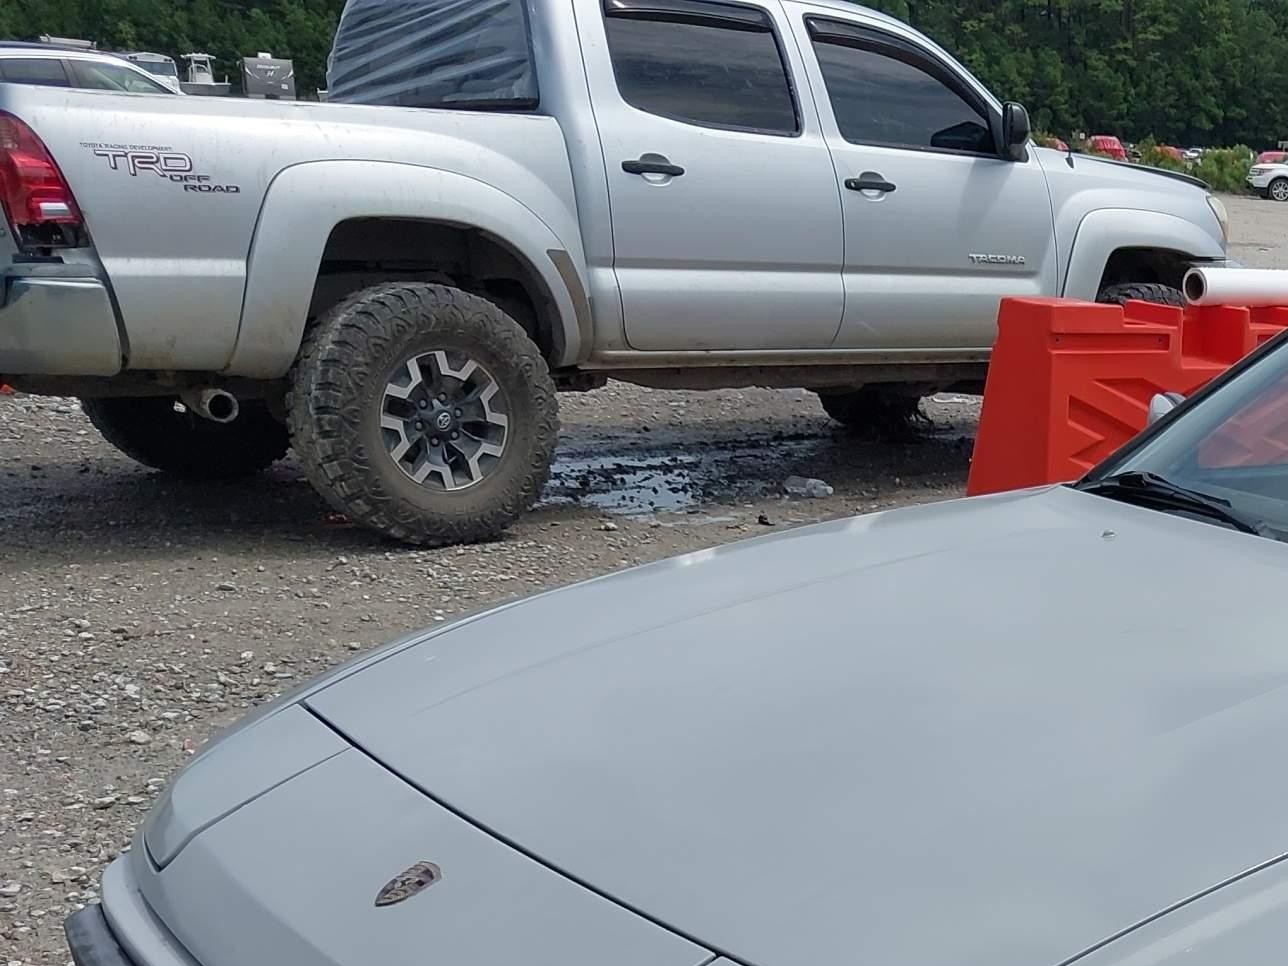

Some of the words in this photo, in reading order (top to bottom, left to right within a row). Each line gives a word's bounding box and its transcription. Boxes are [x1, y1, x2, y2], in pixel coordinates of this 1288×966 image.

[94, 150, 192, 176] TRD
[169, 174, 211, 183] OFF
[183, 184, 240, 193] ROAD
